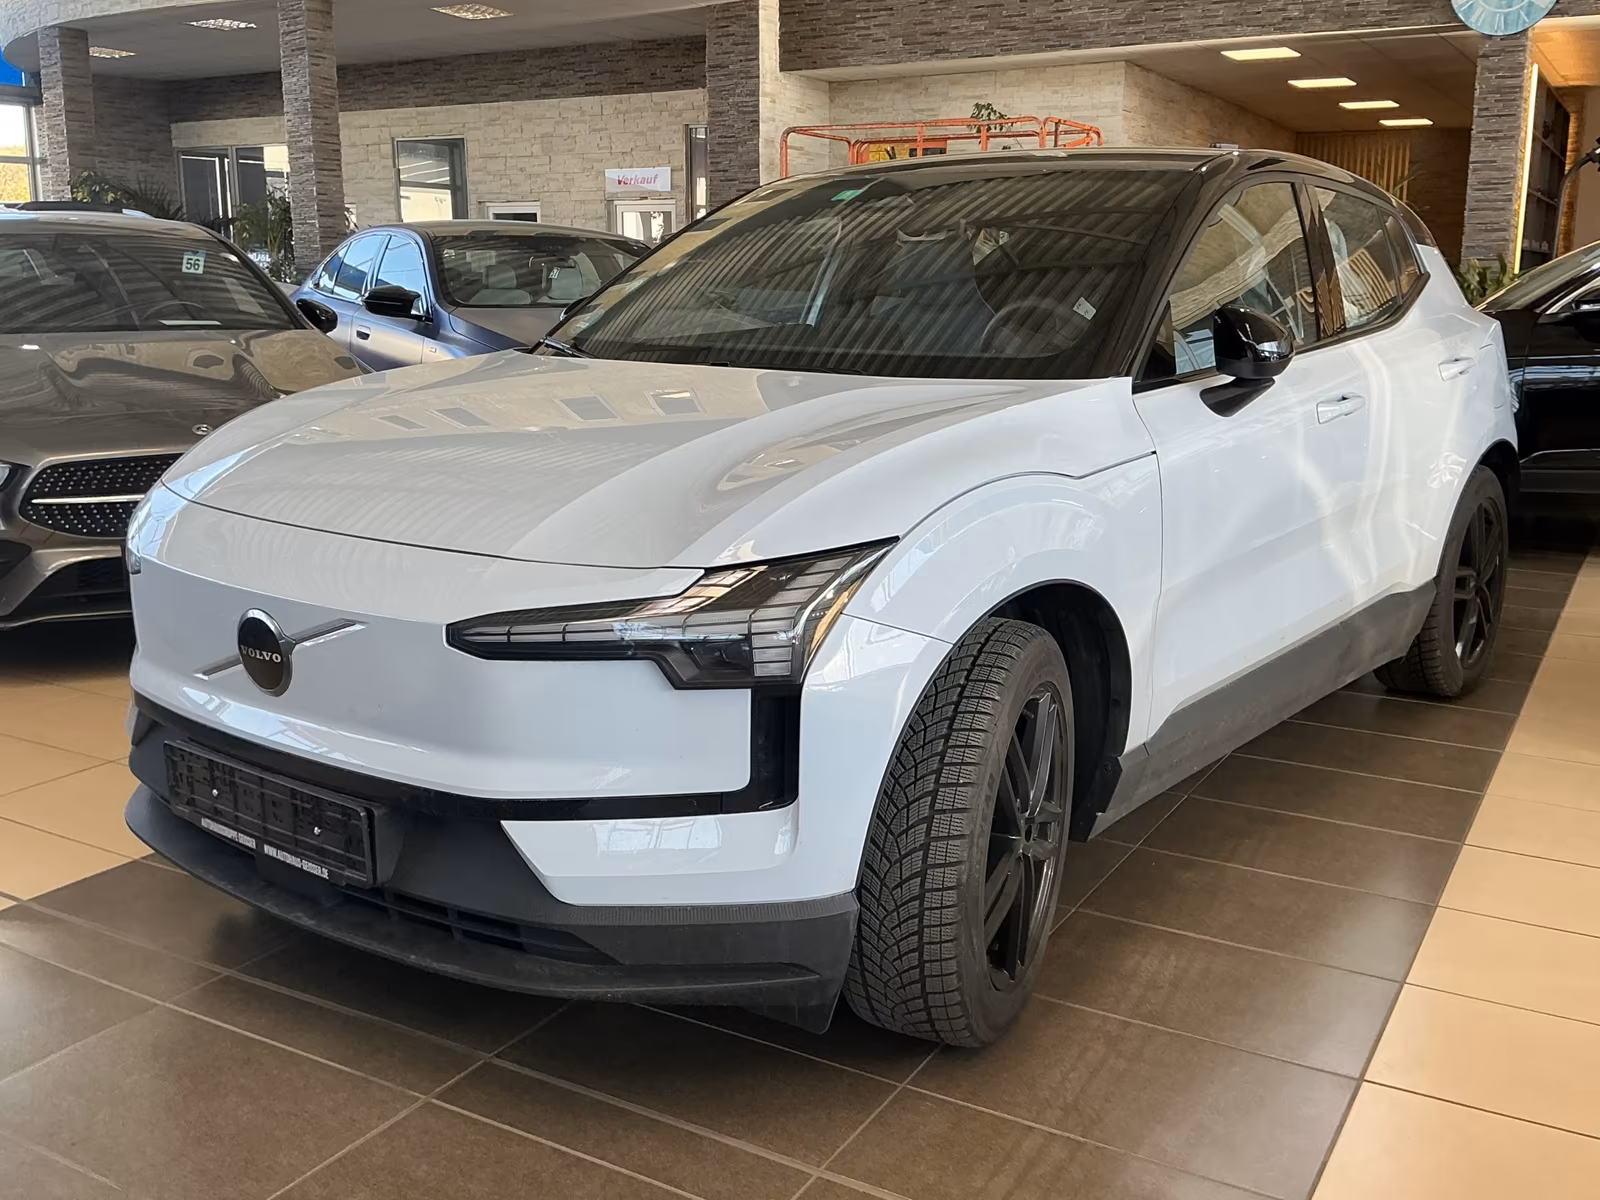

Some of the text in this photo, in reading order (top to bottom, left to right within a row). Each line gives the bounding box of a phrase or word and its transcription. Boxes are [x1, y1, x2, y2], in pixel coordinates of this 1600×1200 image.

[617, 173, 659, 185] Verkauf
[185, 257, 201, 271] 56
[240, 644, 282, 663] VOLVO
